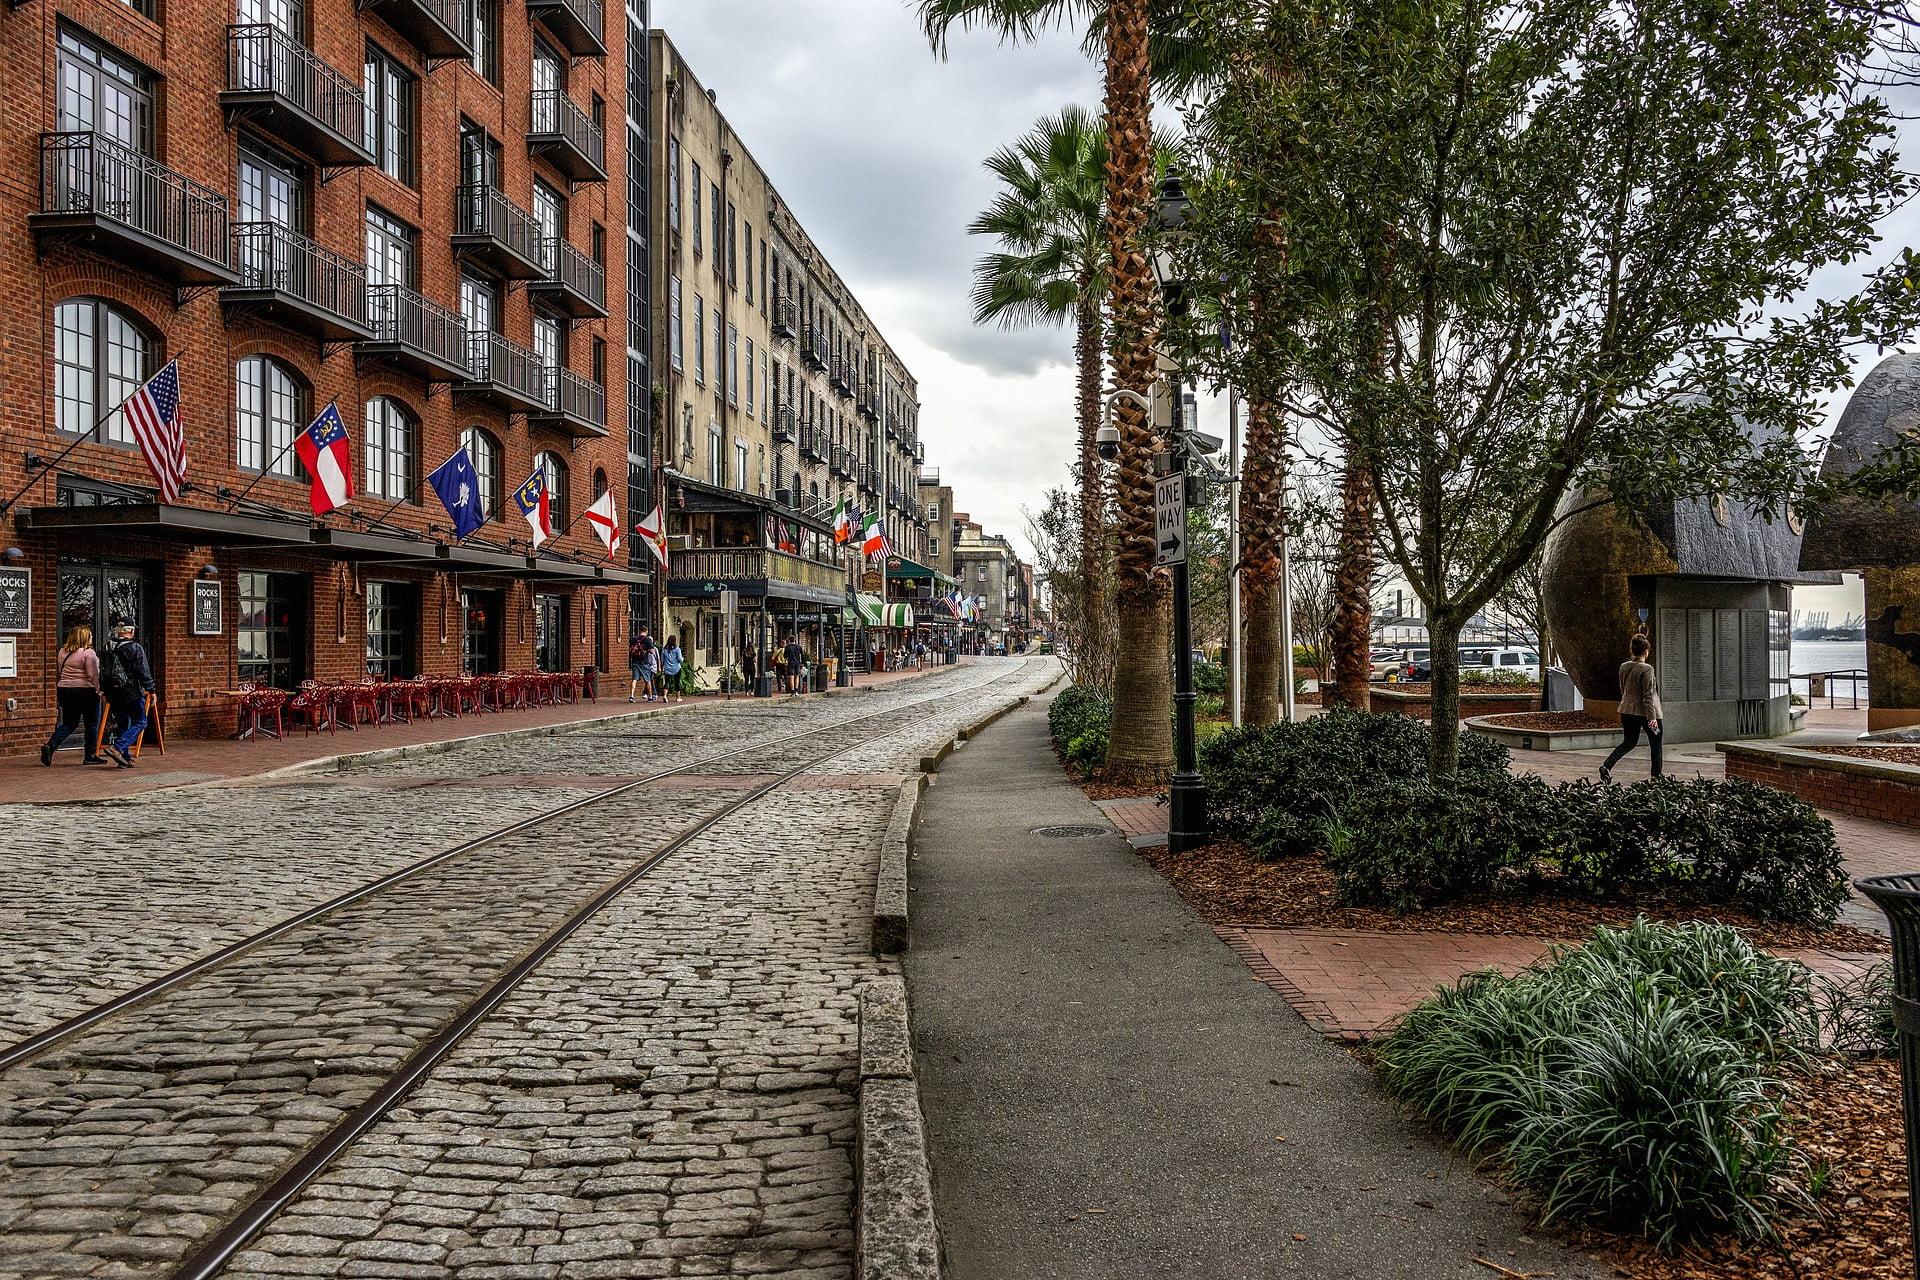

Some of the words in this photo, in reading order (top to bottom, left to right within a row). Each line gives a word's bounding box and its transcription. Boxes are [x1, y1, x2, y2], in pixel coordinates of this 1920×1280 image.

[1158, 482, 1180, 505] ONE
[1158, 506, 1181, 530] WAY
[0, 577, 26, 588] OCKS
[197, 588, 218, 598] ROCKS
[674, 598, 700, 606] KEVIN
[737, 597, 756, 606] PUB
